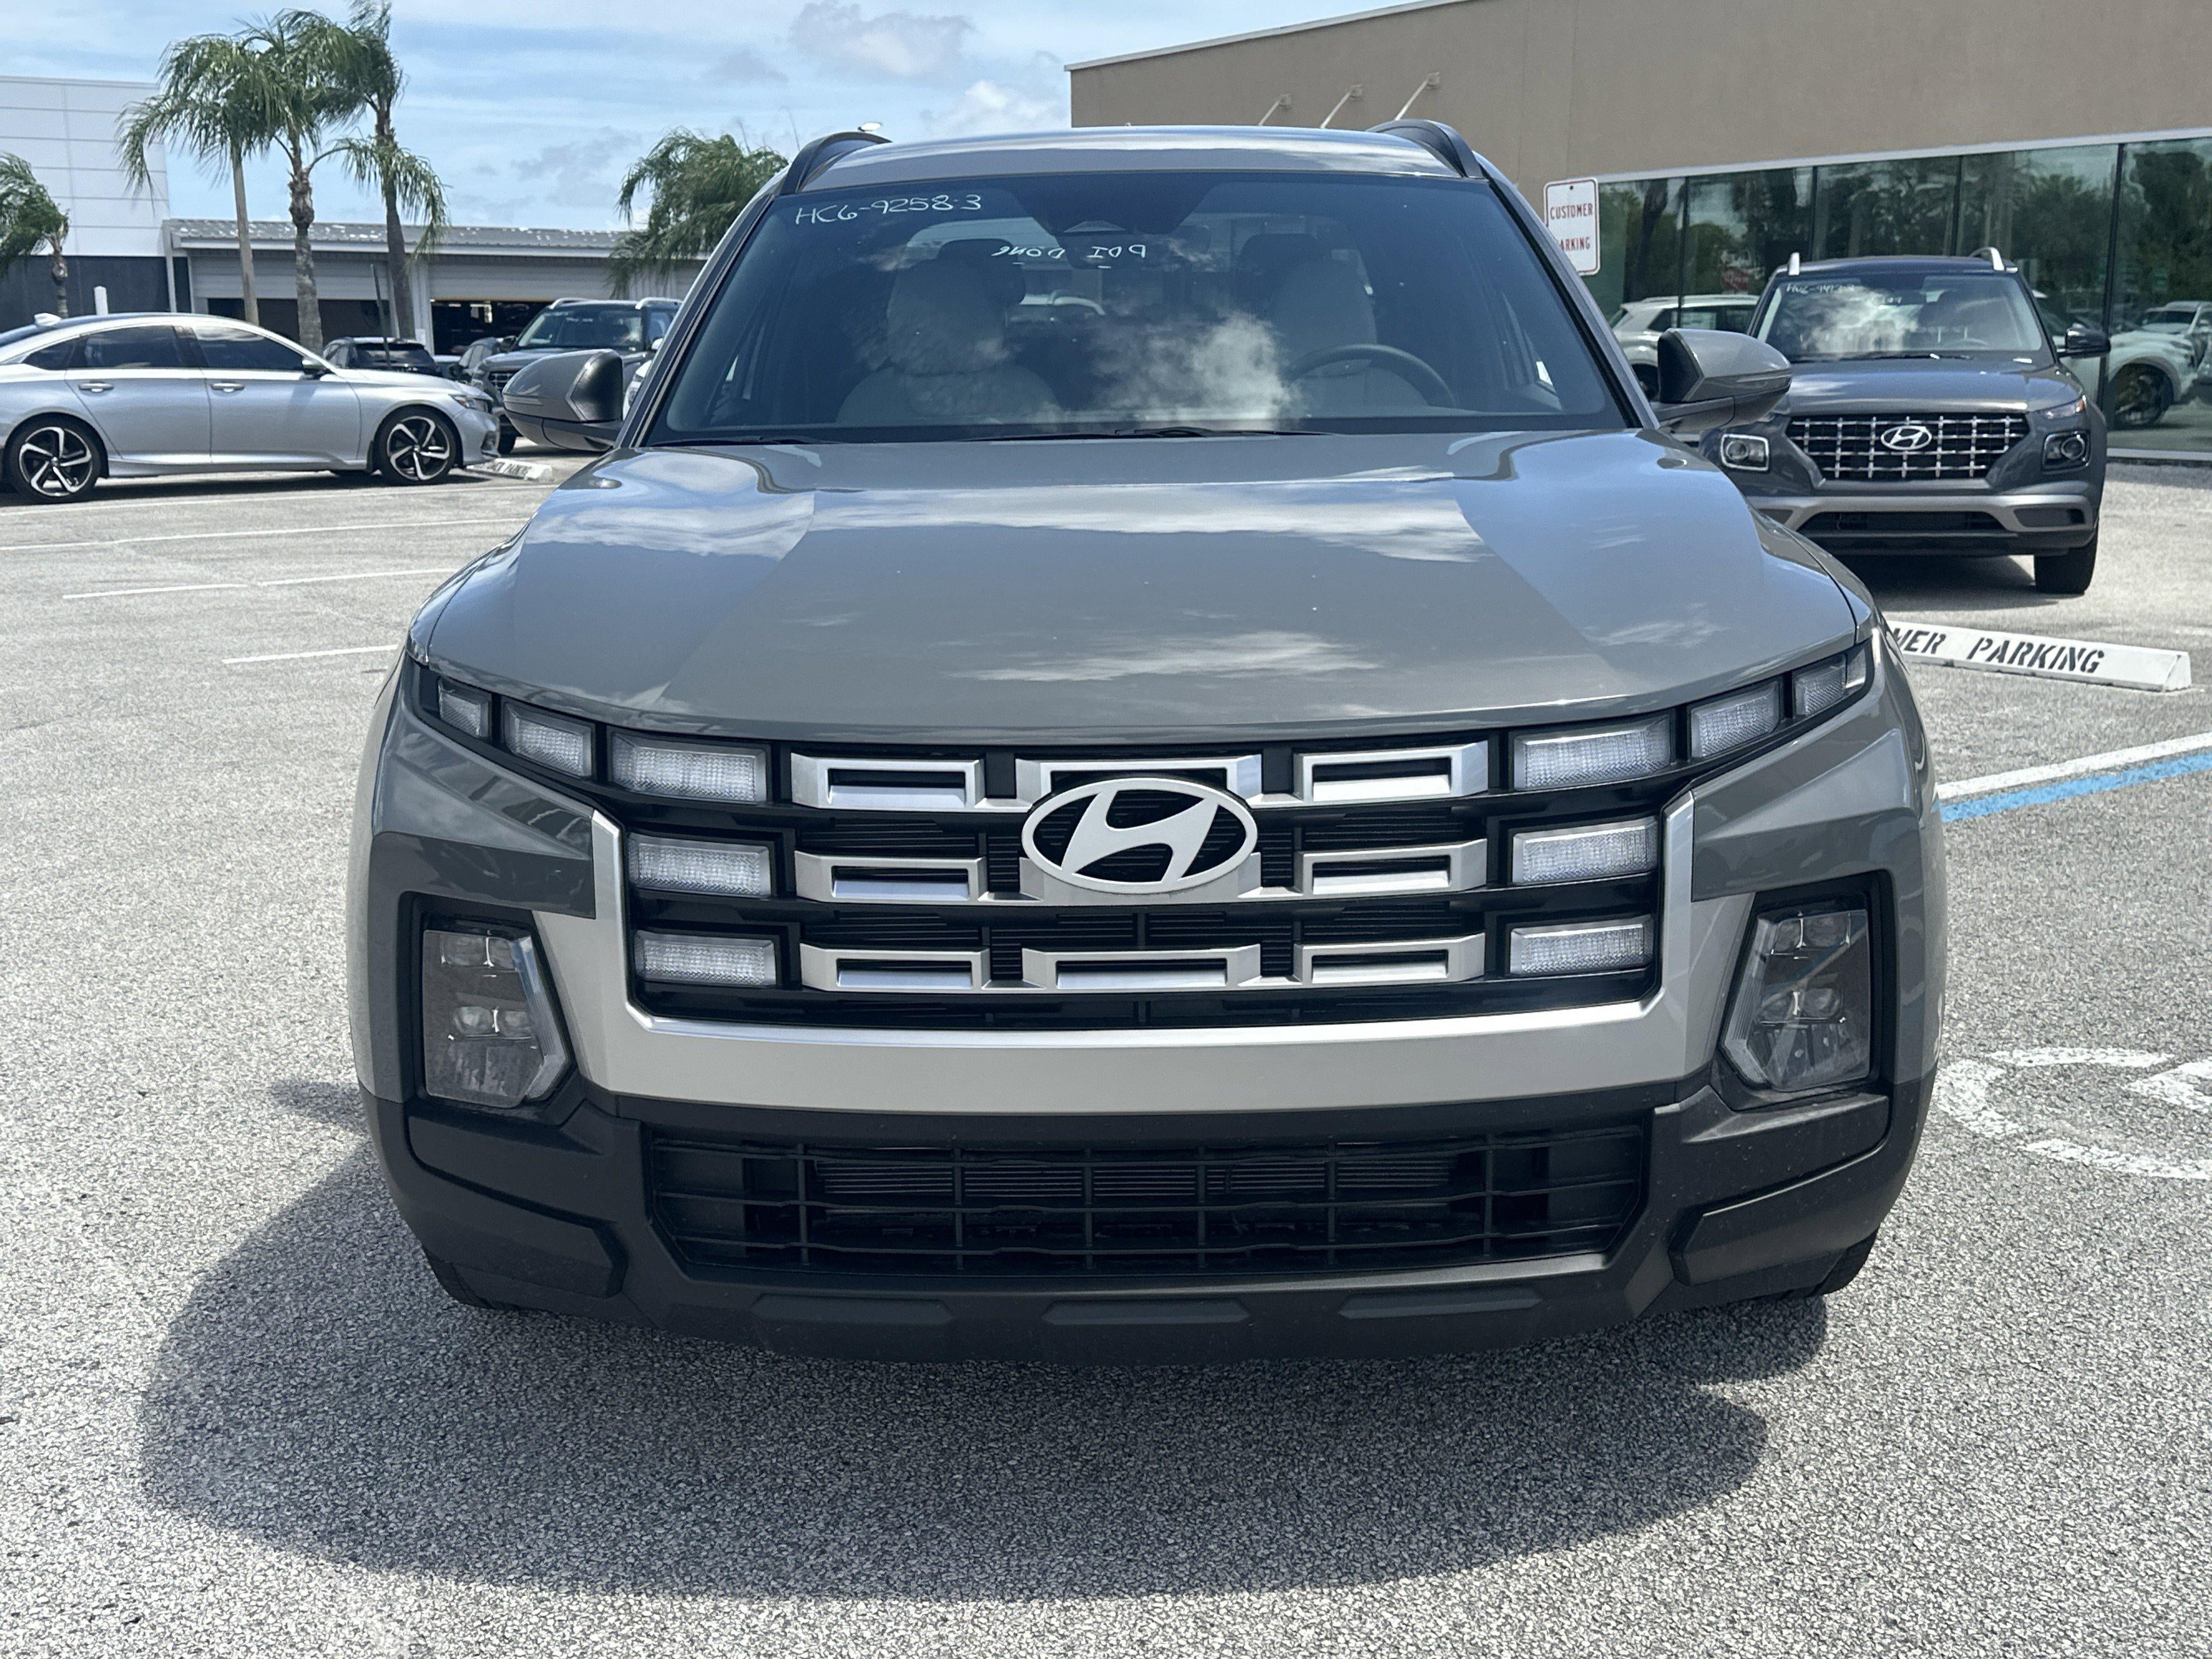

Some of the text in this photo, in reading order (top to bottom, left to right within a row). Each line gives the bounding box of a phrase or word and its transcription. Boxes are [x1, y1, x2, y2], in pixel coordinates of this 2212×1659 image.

[1550, 203, 1593, 219] CUSTOMER
[1560, 236, 1590, 251] ARKING
[1893, 628, 2104, 673] MER PARKING
